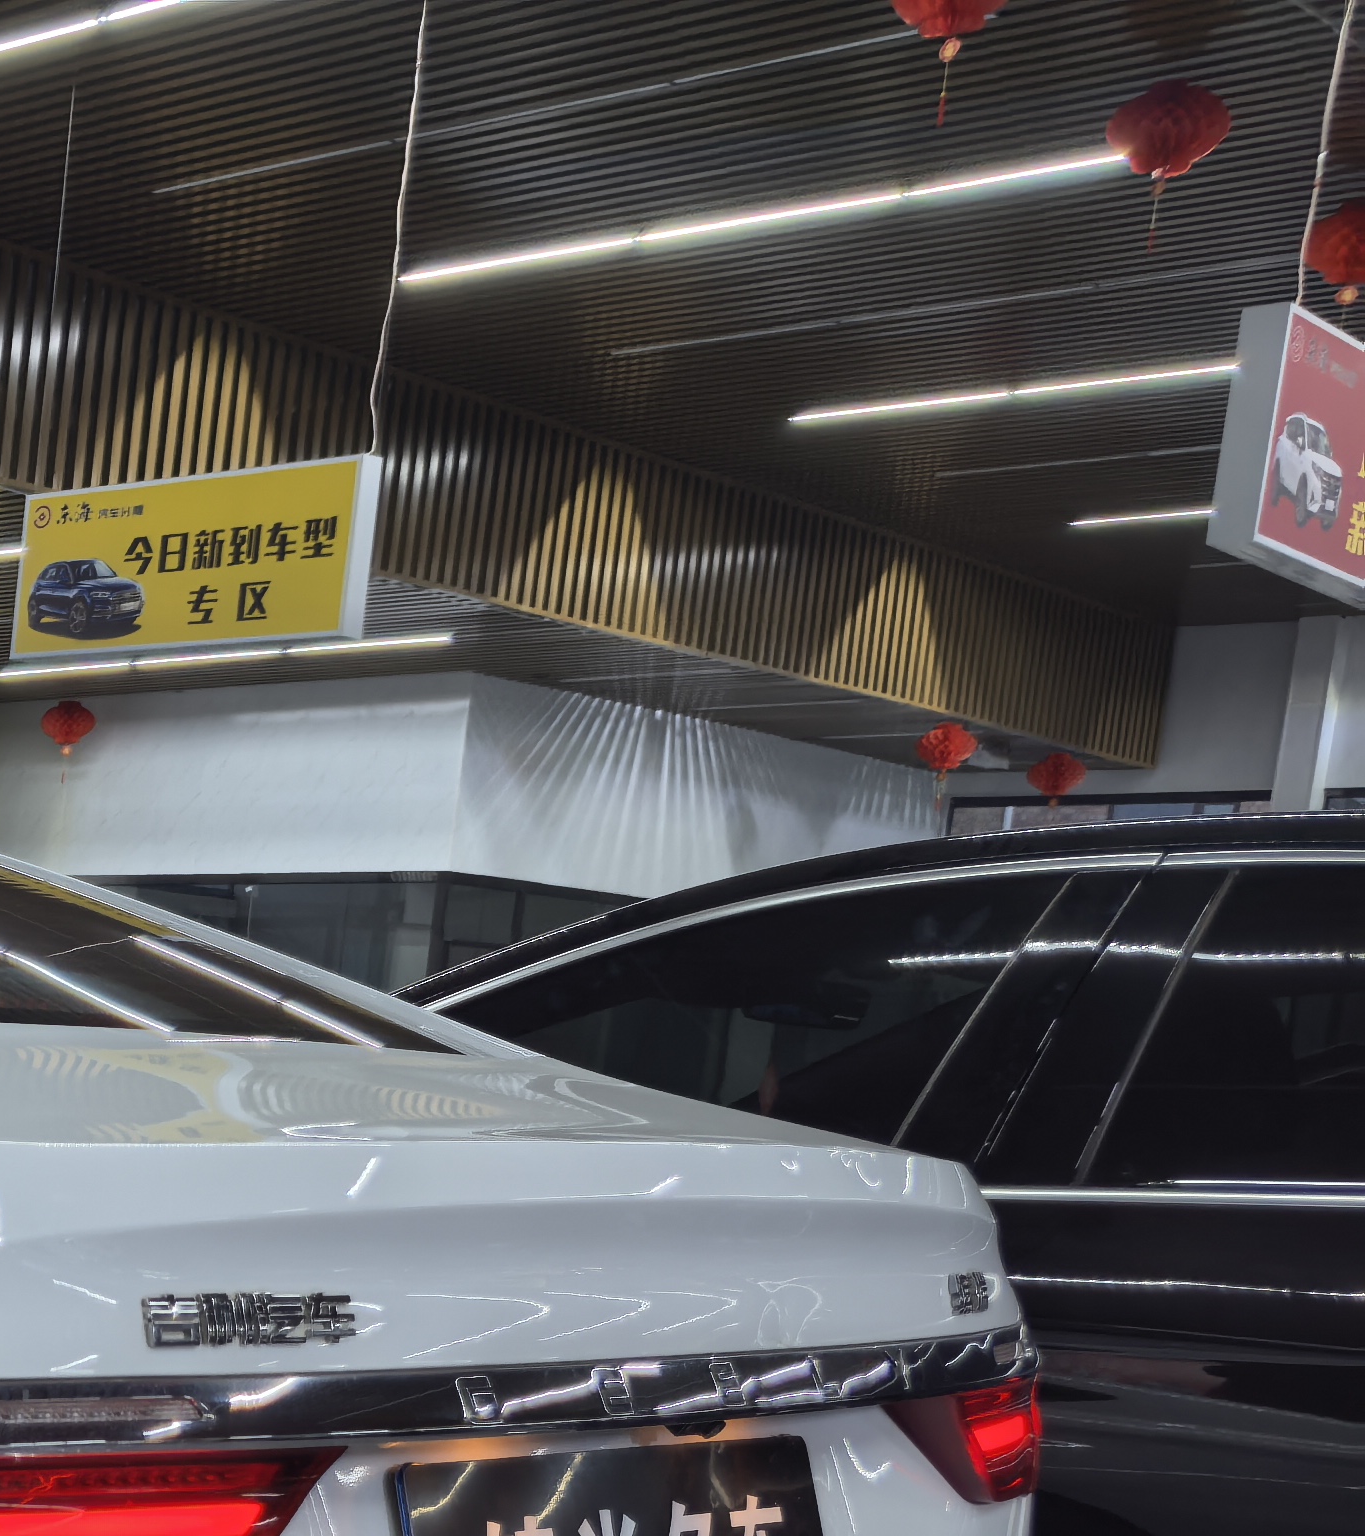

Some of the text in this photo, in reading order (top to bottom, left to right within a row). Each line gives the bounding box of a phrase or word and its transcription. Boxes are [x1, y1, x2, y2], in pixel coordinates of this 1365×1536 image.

[122, 515, 339, 577] 今日新到车型
[187, 580, 273, 626] 专区
